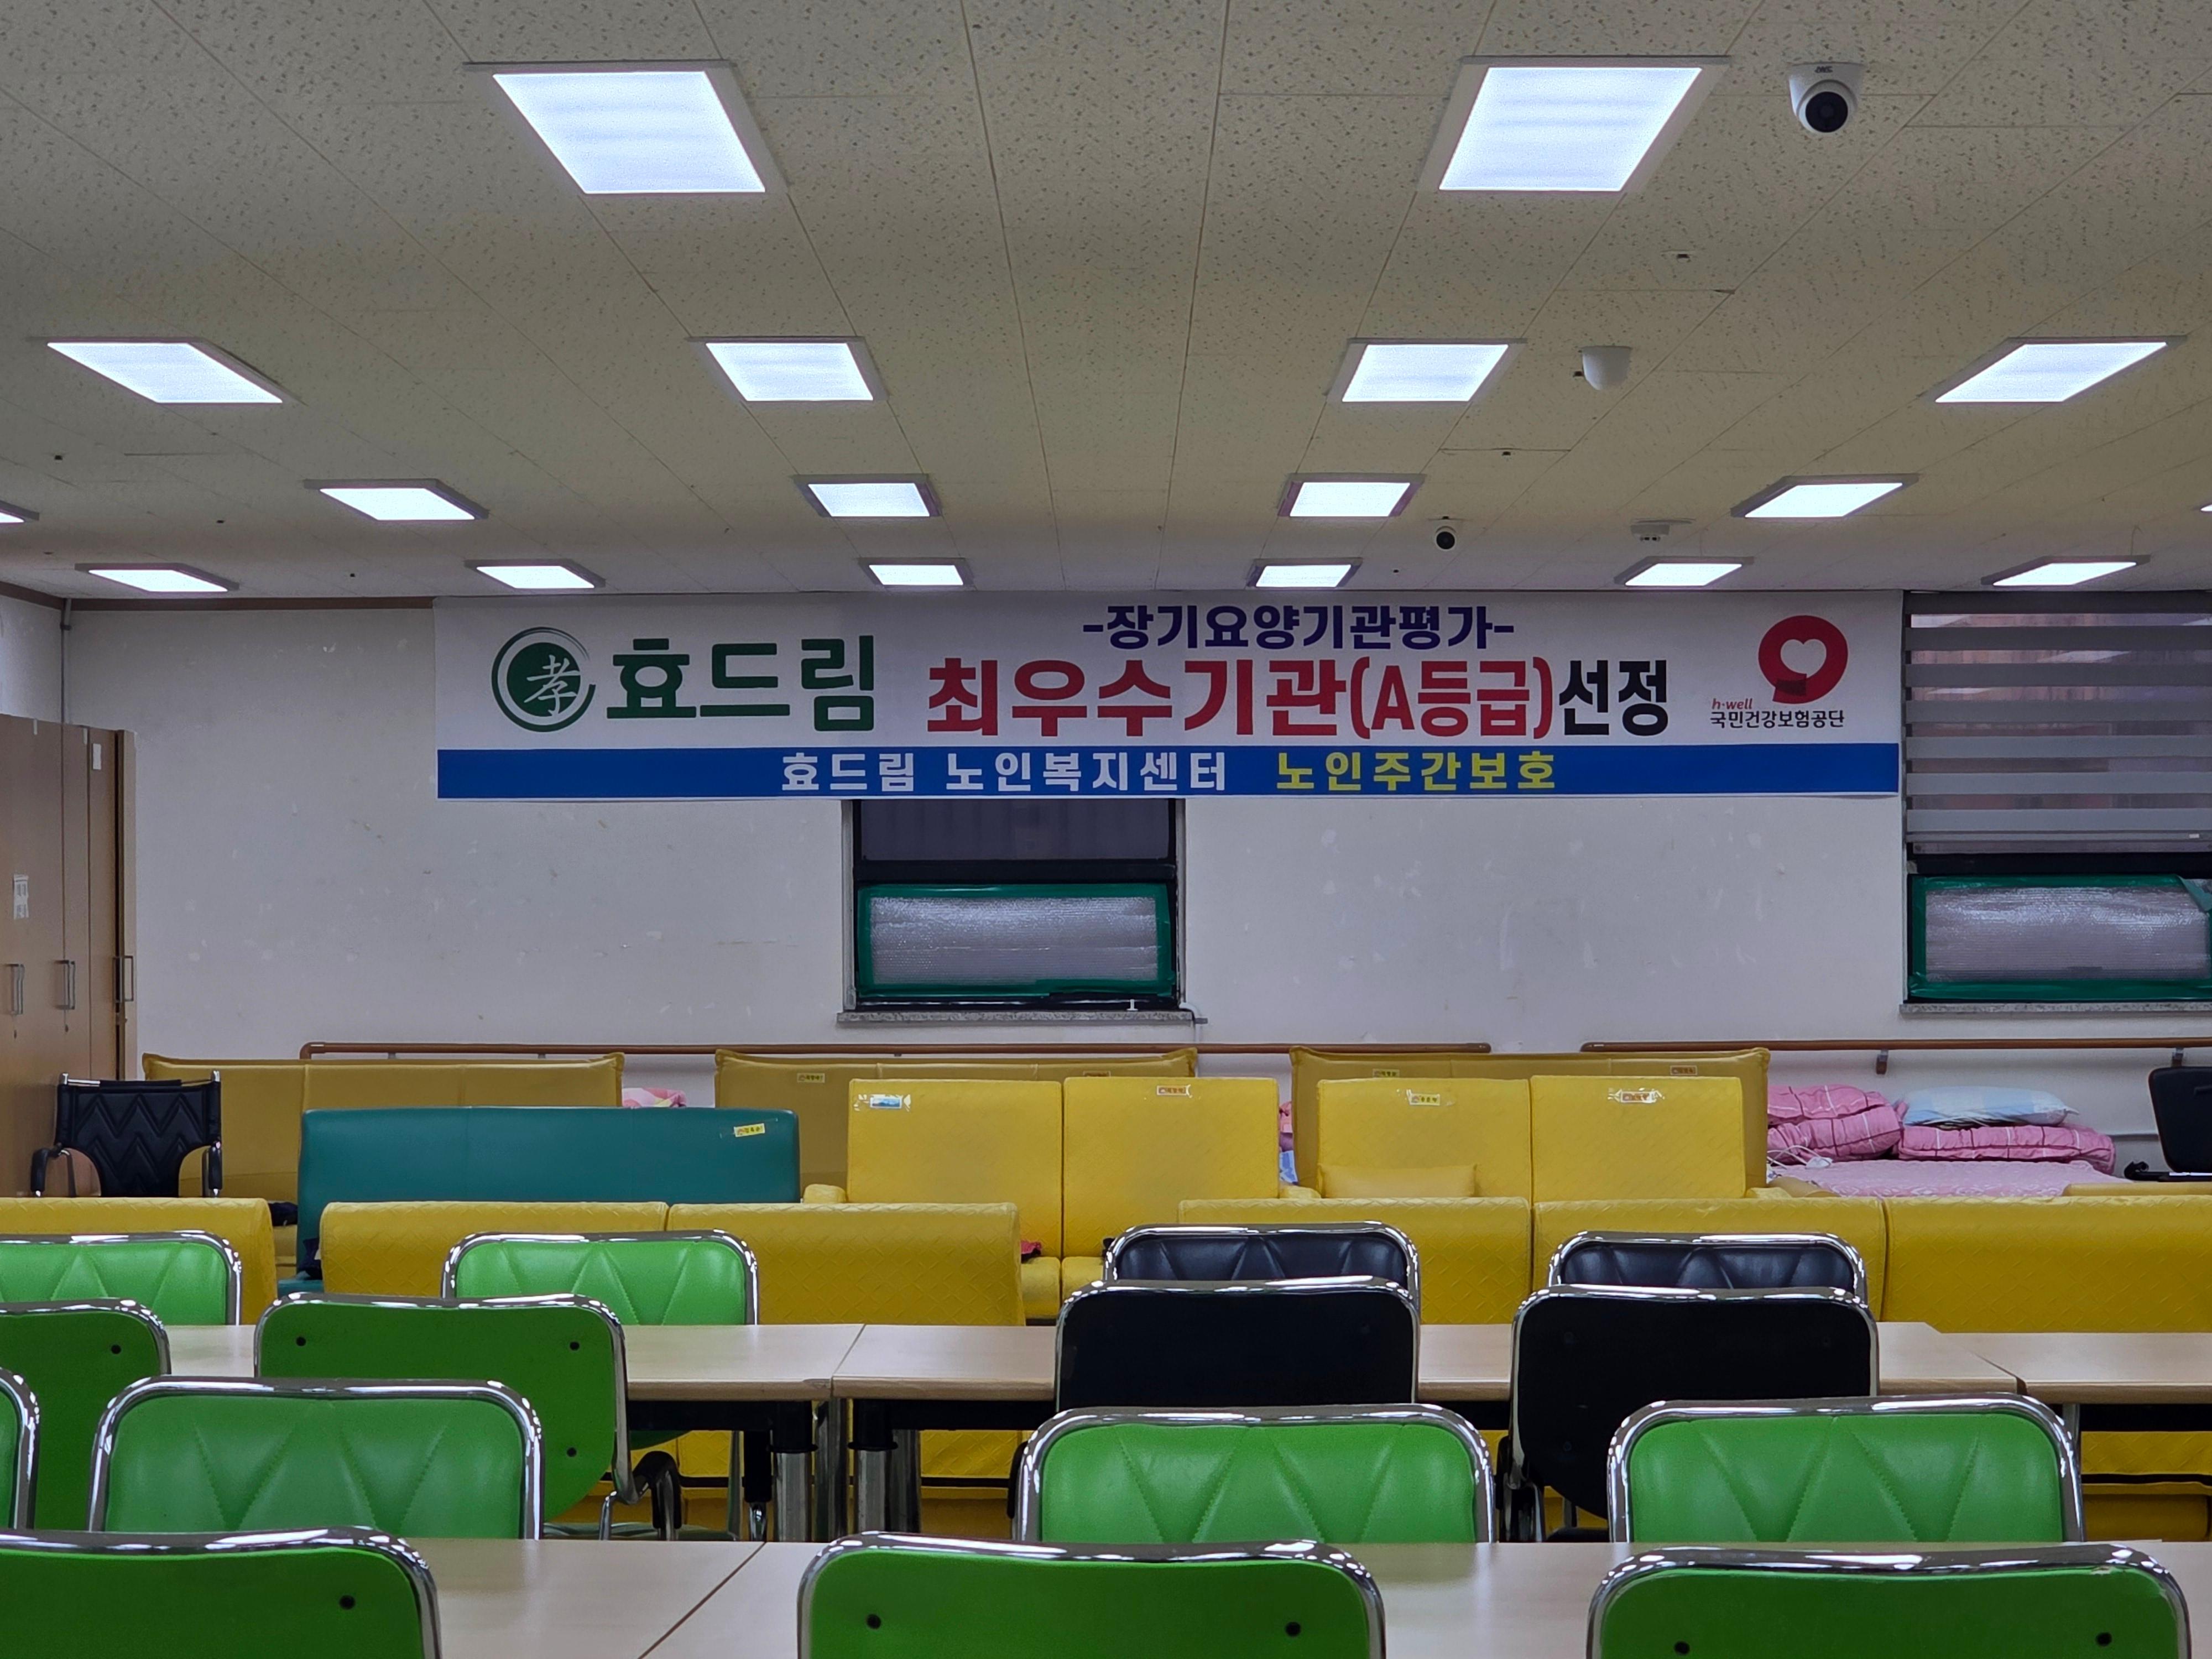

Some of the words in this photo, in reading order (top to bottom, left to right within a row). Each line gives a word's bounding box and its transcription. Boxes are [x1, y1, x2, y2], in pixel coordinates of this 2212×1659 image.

[524, 654, 581, 716] 孝
[607, 635, 875, 732] 효드림
[1710, 709, 1845, 729] 국민건강보험공단
[781, 752, 915, 792] 효드림
[946, 752, 1226, 791] 노인복지센터
[1276, 750, 1556, 791] 노인주간보호
